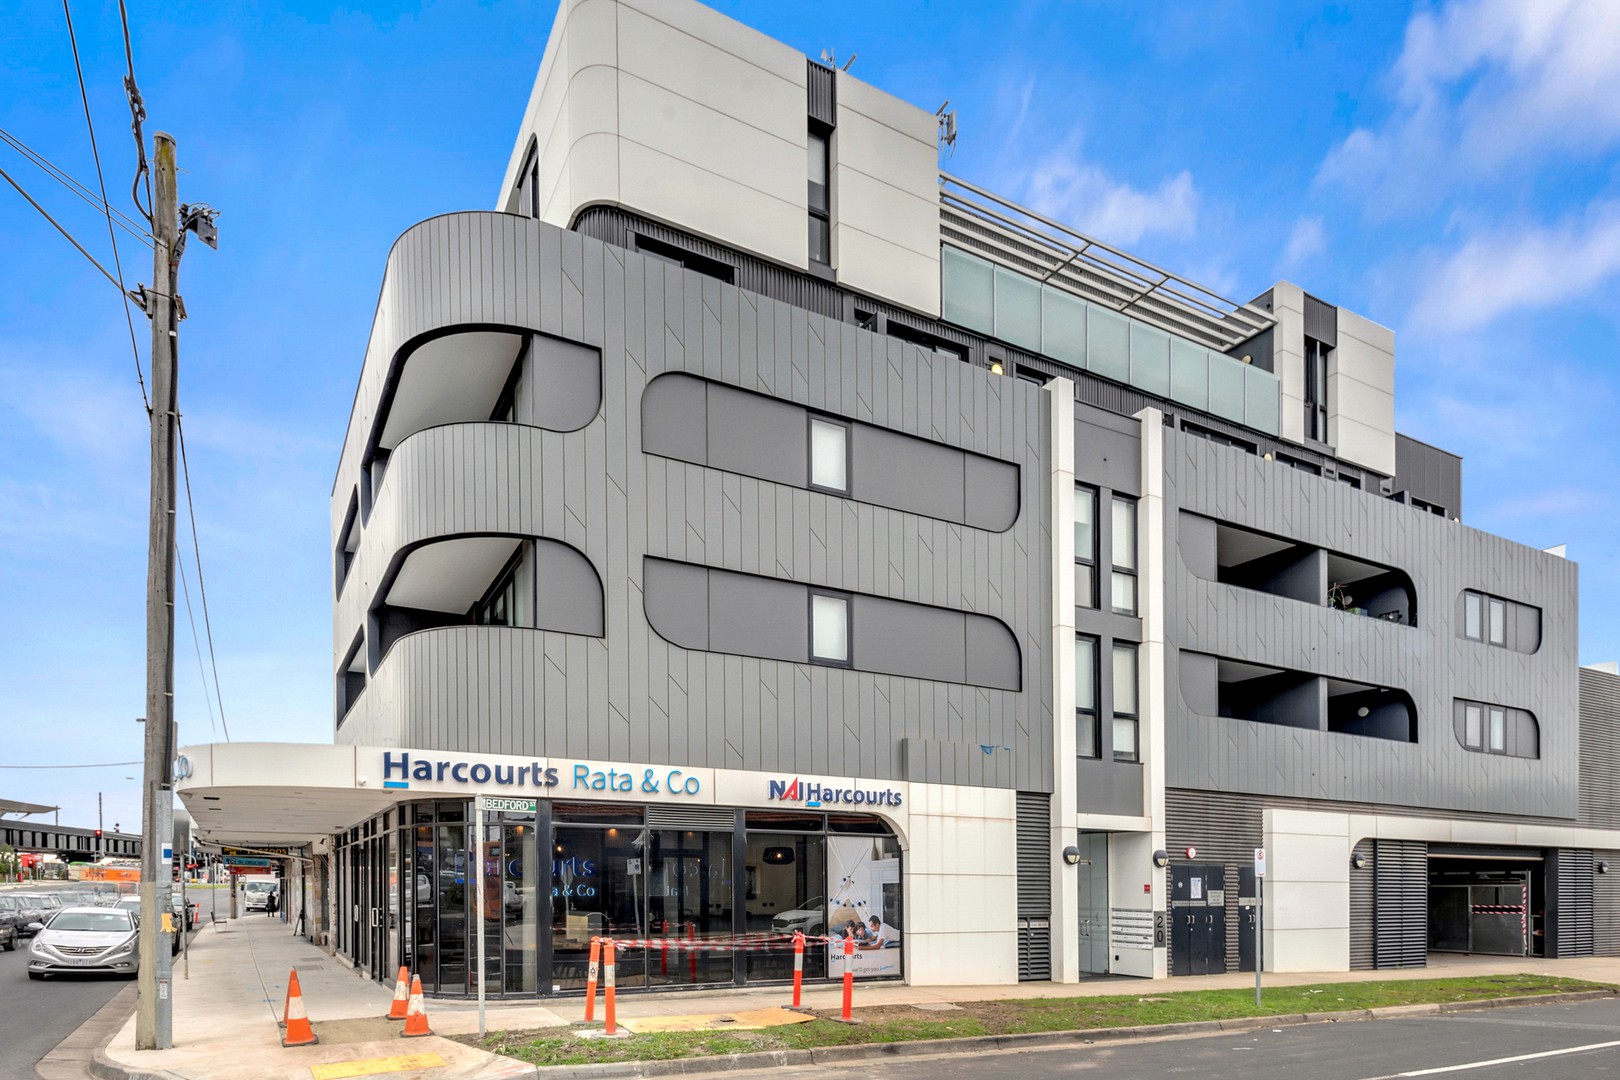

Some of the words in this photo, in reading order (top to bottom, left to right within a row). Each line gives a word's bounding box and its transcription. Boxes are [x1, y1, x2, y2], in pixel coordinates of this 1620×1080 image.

[383, 751, 559, 787] Harcourts
[573, 764, 633, 792] Rata
[641, 768, 660, 794] &
[667, 770, 700, 795] Co
[769, 777, 803, 800] NAI
[806, 783, 902, 806] Harcourts
[486, 798, 529, 811] BEDFORD
[830, 953, 863, 961] Harcrts
